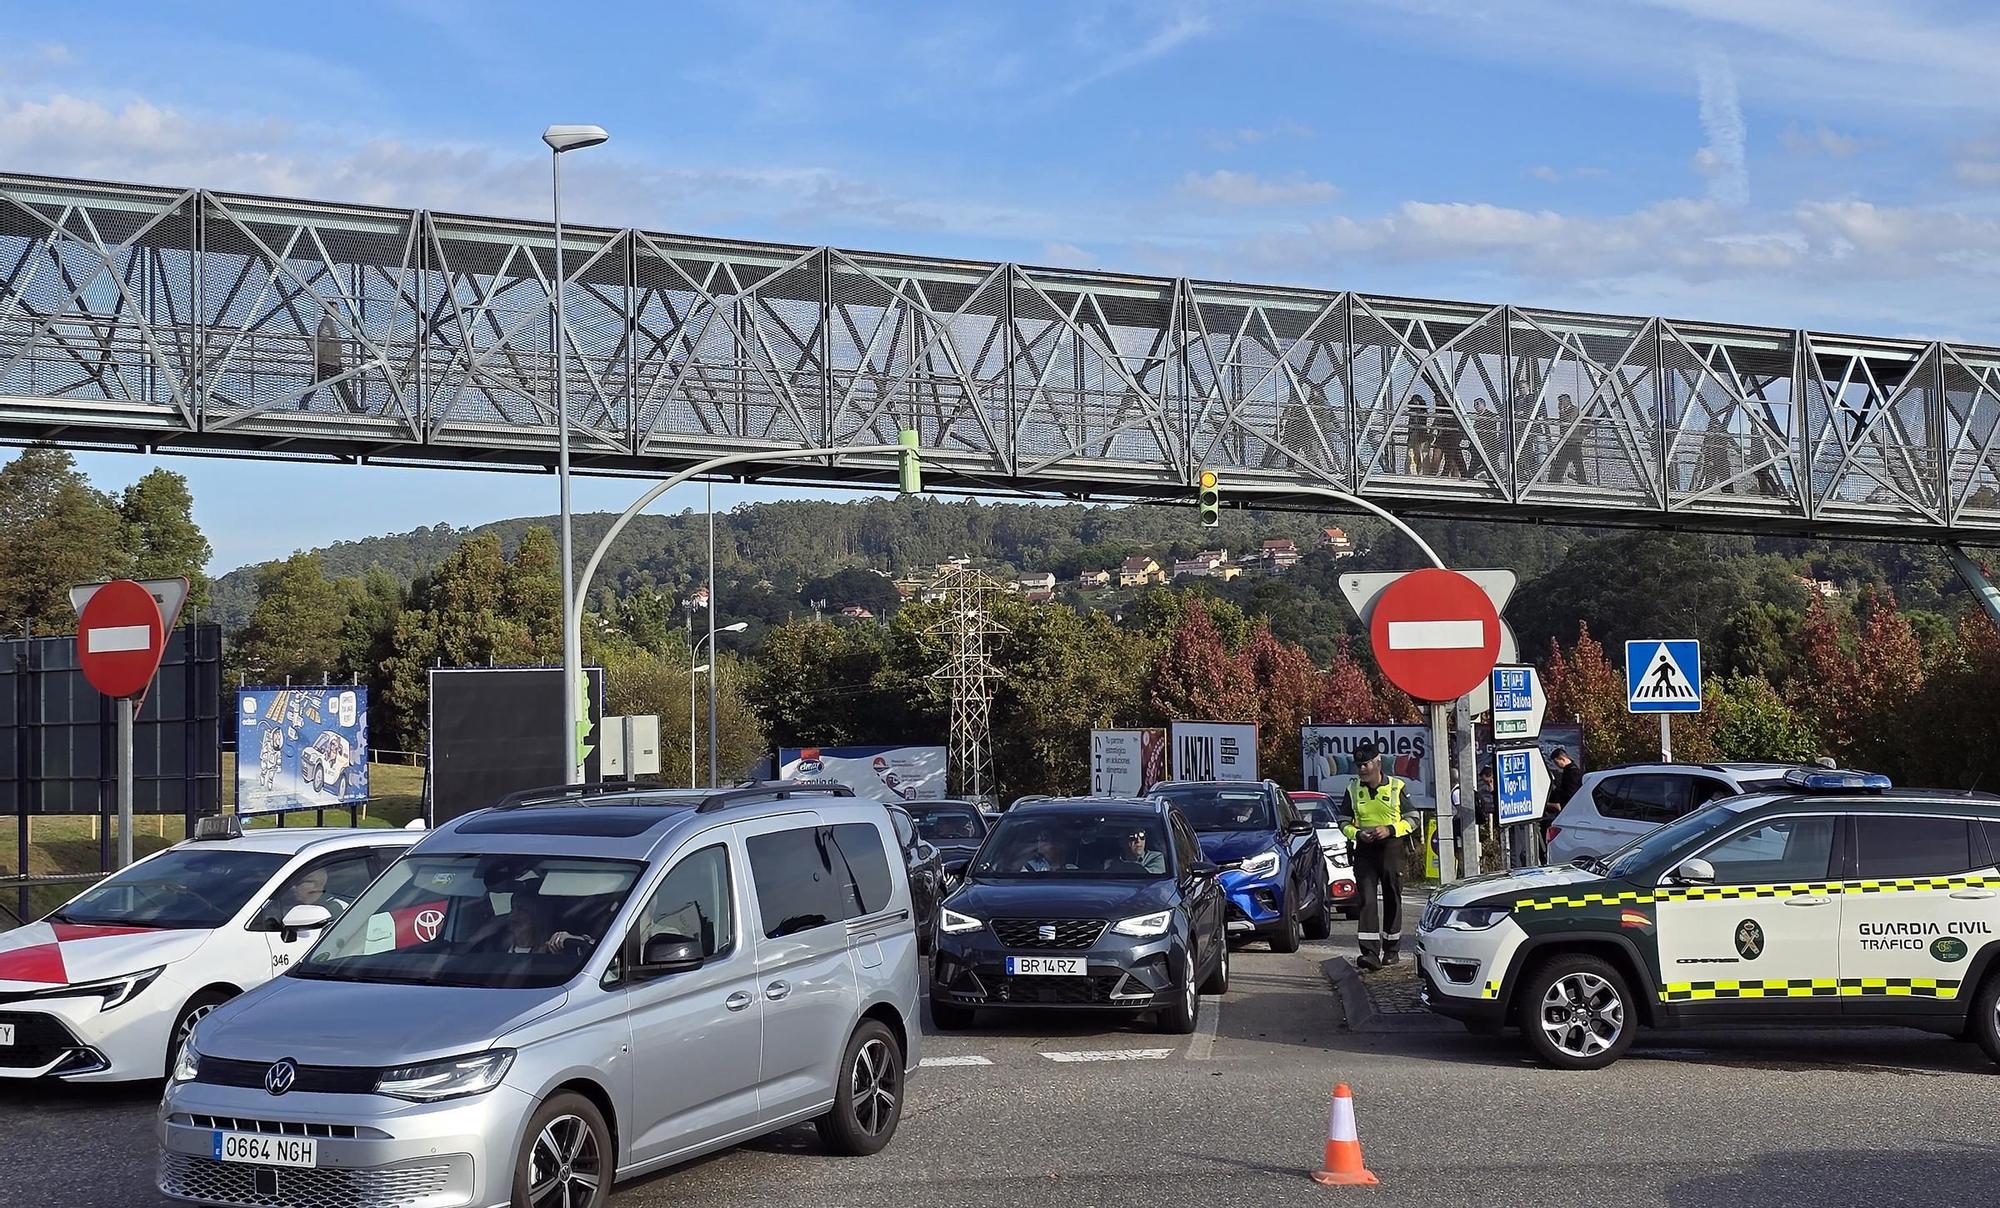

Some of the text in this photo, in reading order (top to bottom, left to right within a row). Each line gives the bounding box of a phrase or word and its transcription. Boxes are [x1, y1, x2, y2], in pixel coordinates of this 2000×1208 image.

[1512, 673, 1523, 688] AP-9
[1496, 692, 1532, 708] AG-57 Baiona
[1514, 757, 1525, 771] AP-9
[1504, 775, 1527, 795] Vigo-Tui
[1501, 799, 1532, 816] Pontevedra
[1859, 921, 1992, 936] GUARDIA CIVIL
[1860, 937, 1923, 950] TRÁFICO
[272, 954, 289, 967] 346
[1021, 959, 1077, 973] BR 14 RZ
[226, 1137, 312, 1163] 0664 NGH
